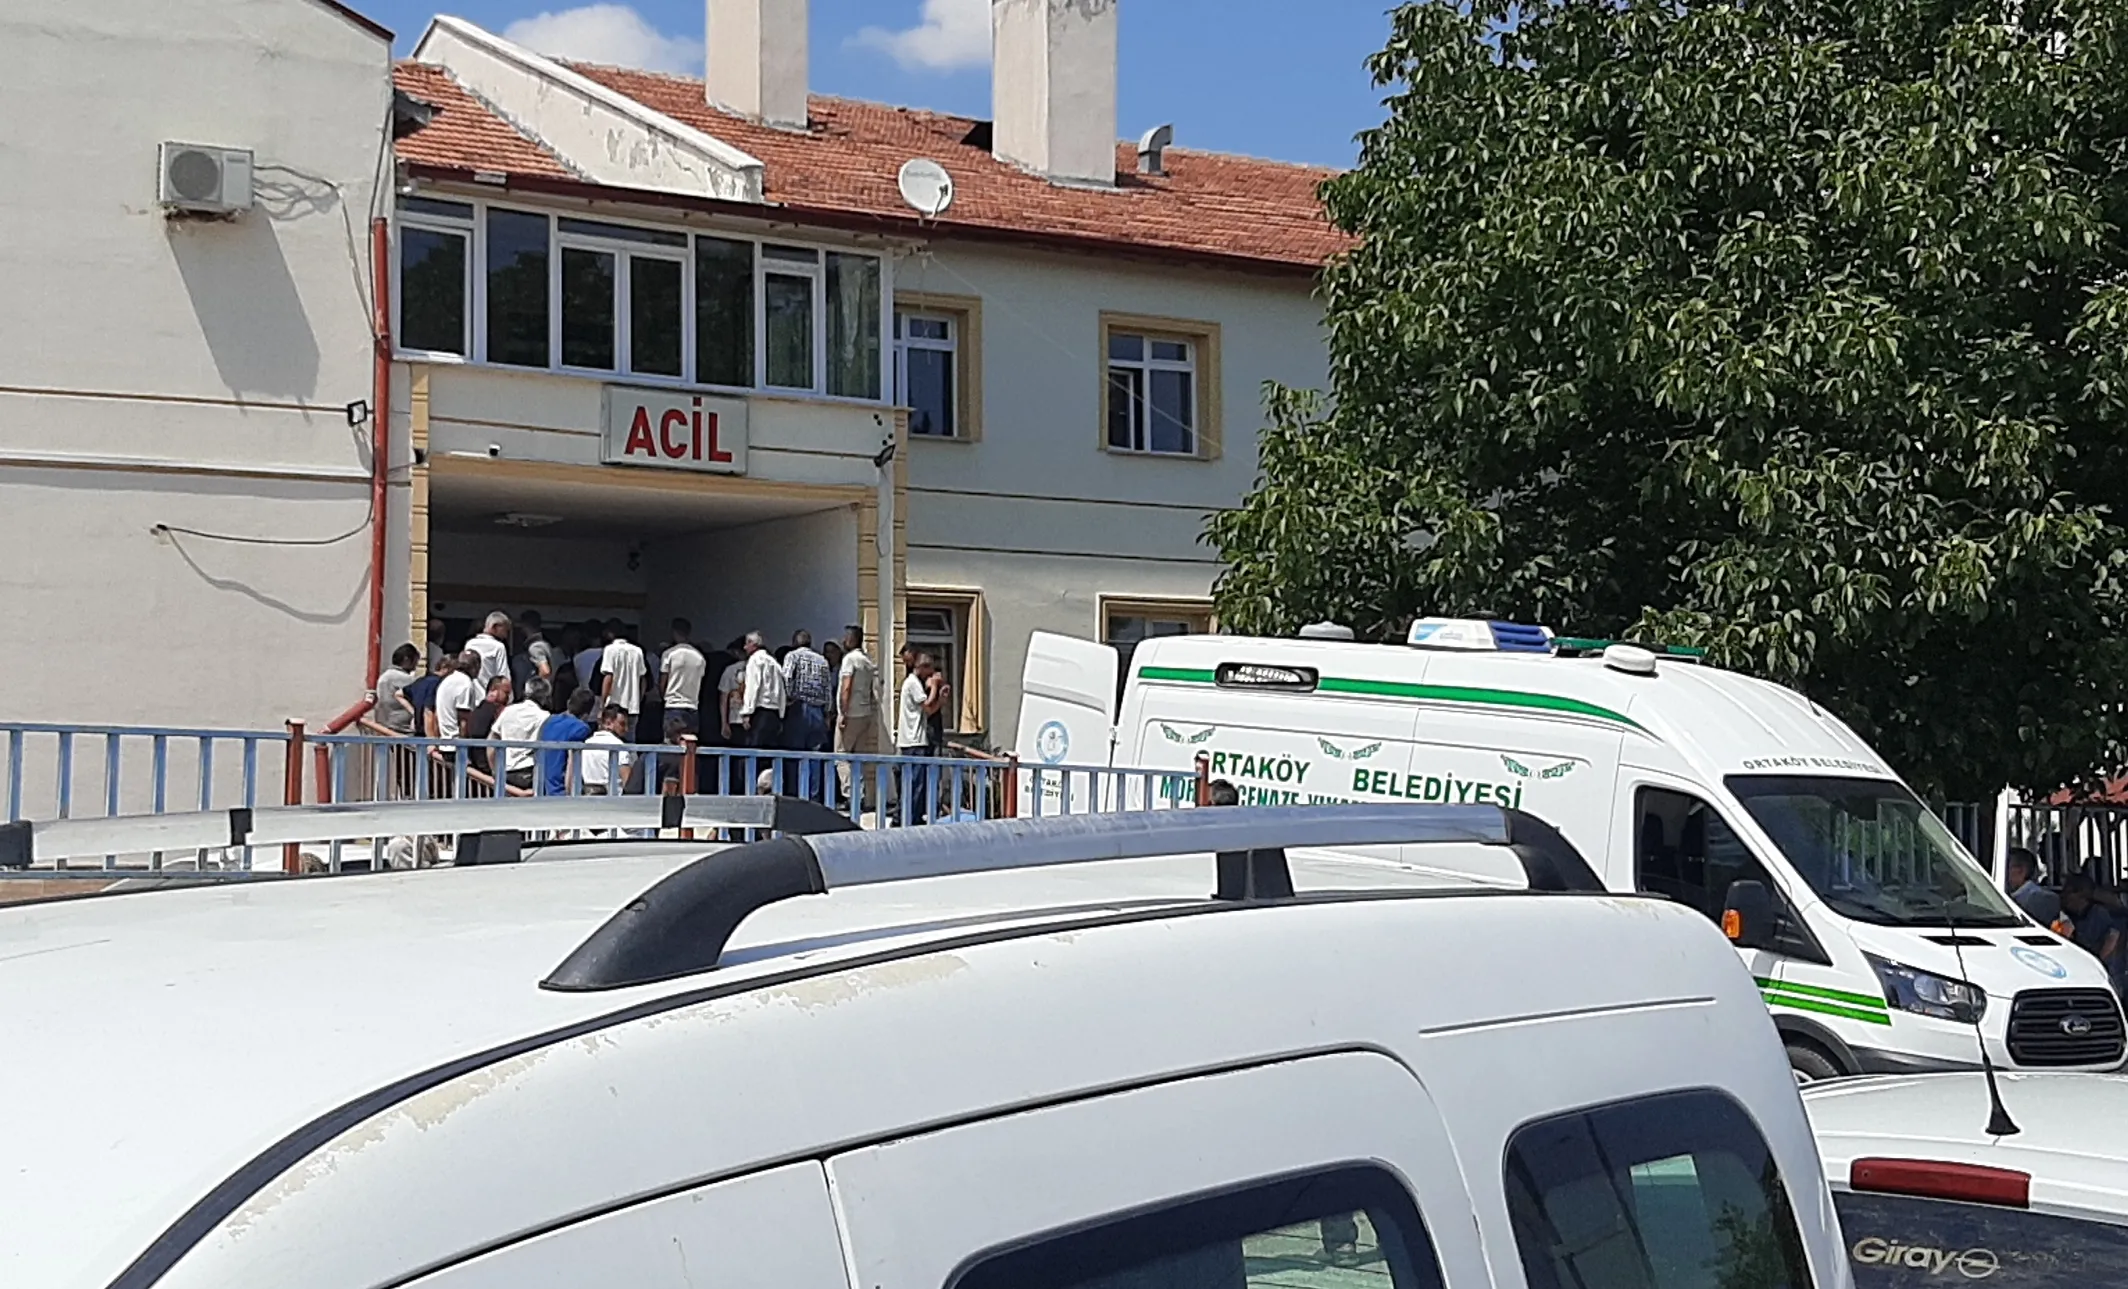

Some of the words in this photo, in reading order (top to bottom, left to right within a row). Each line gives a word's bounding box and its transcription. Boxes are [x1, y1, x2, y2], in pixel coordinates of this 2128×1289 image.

[624, 396, 732, 463] ACİL
[1197, 750, 1311, 784] RTAKÖY
[1353, 767, 1523, 809] BELEDİYESİ
[1853, 1237, 1957, 1275] Giray
